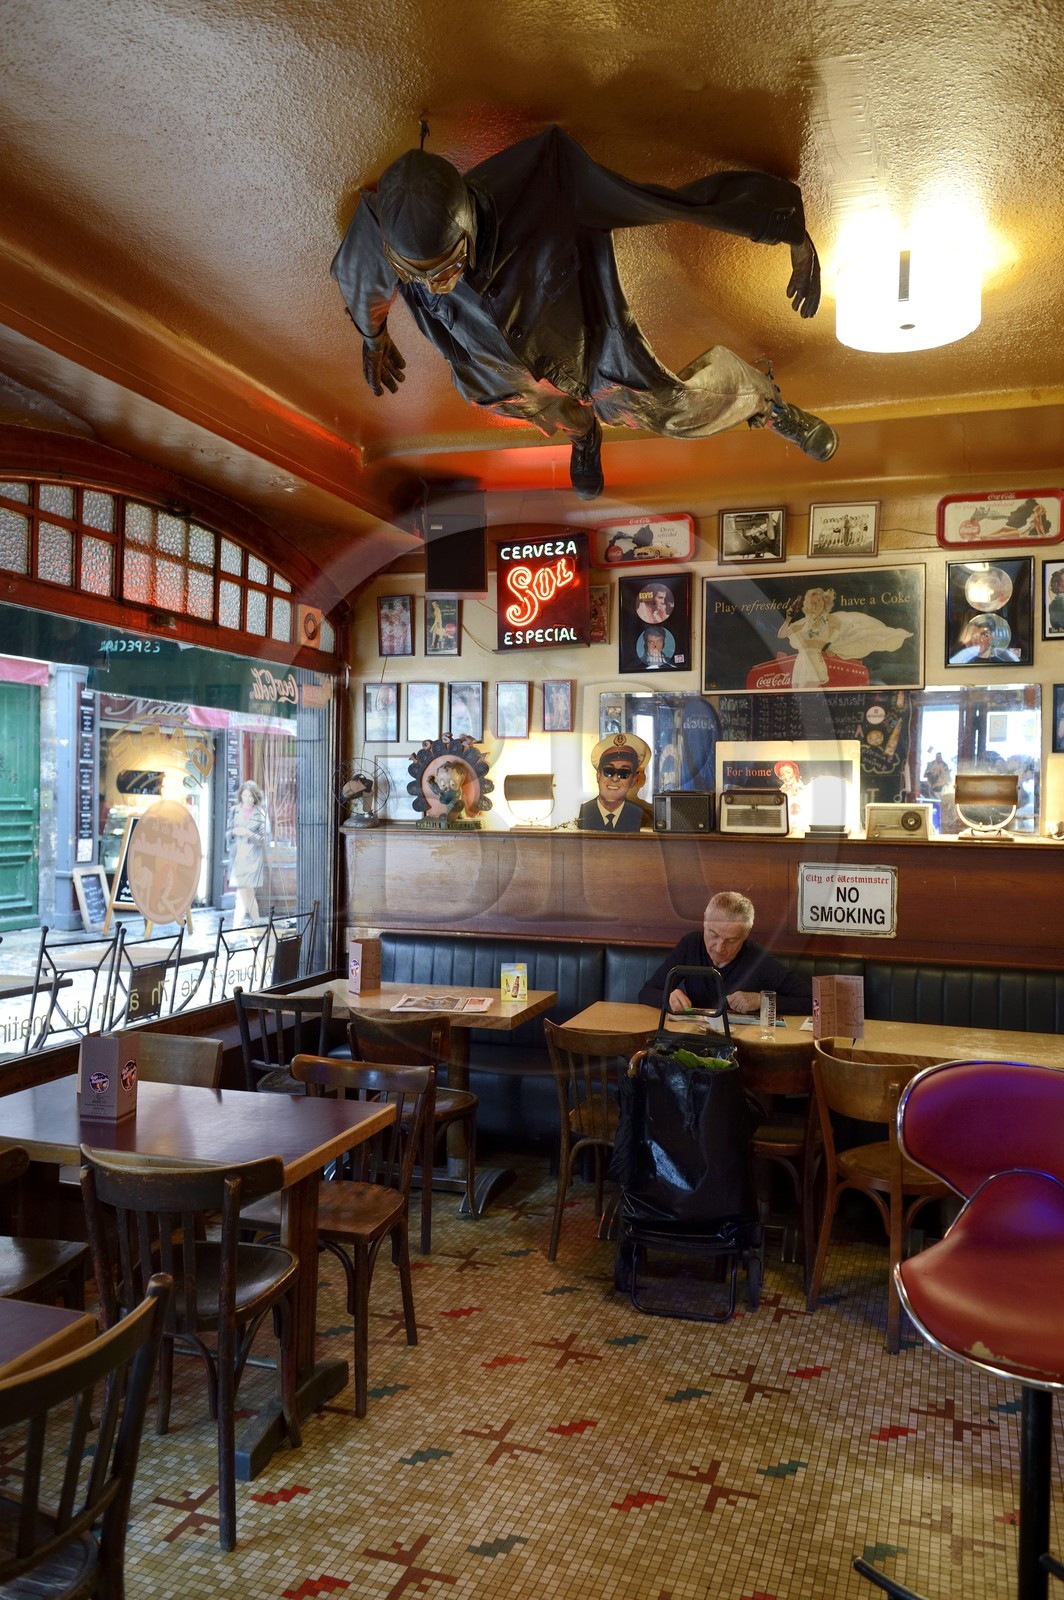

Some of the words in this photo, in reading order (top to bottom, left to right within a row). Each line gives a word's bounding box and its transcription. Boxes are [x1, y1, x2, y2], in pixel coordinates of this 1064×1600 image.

[500, 540, 577, 561] CERVEZA
[638, 591, 654, 600] ELVIS
[714, 601, 737, 614] Play
[840, 595, 866, 606] have
[880, 591, 911, 605] Coke
[503, 626, 578, 646] ESPECIAL
[726, 766, 742, 777] For
[745, 766, 772, 777] home
[805, 873, 823, 884] City
[825, 873, 835, 882] of
[837, 874, 890, 885] Westminster
[836, 886, 860, 903] NO
[809, 905, 886, 925] SMOKING
